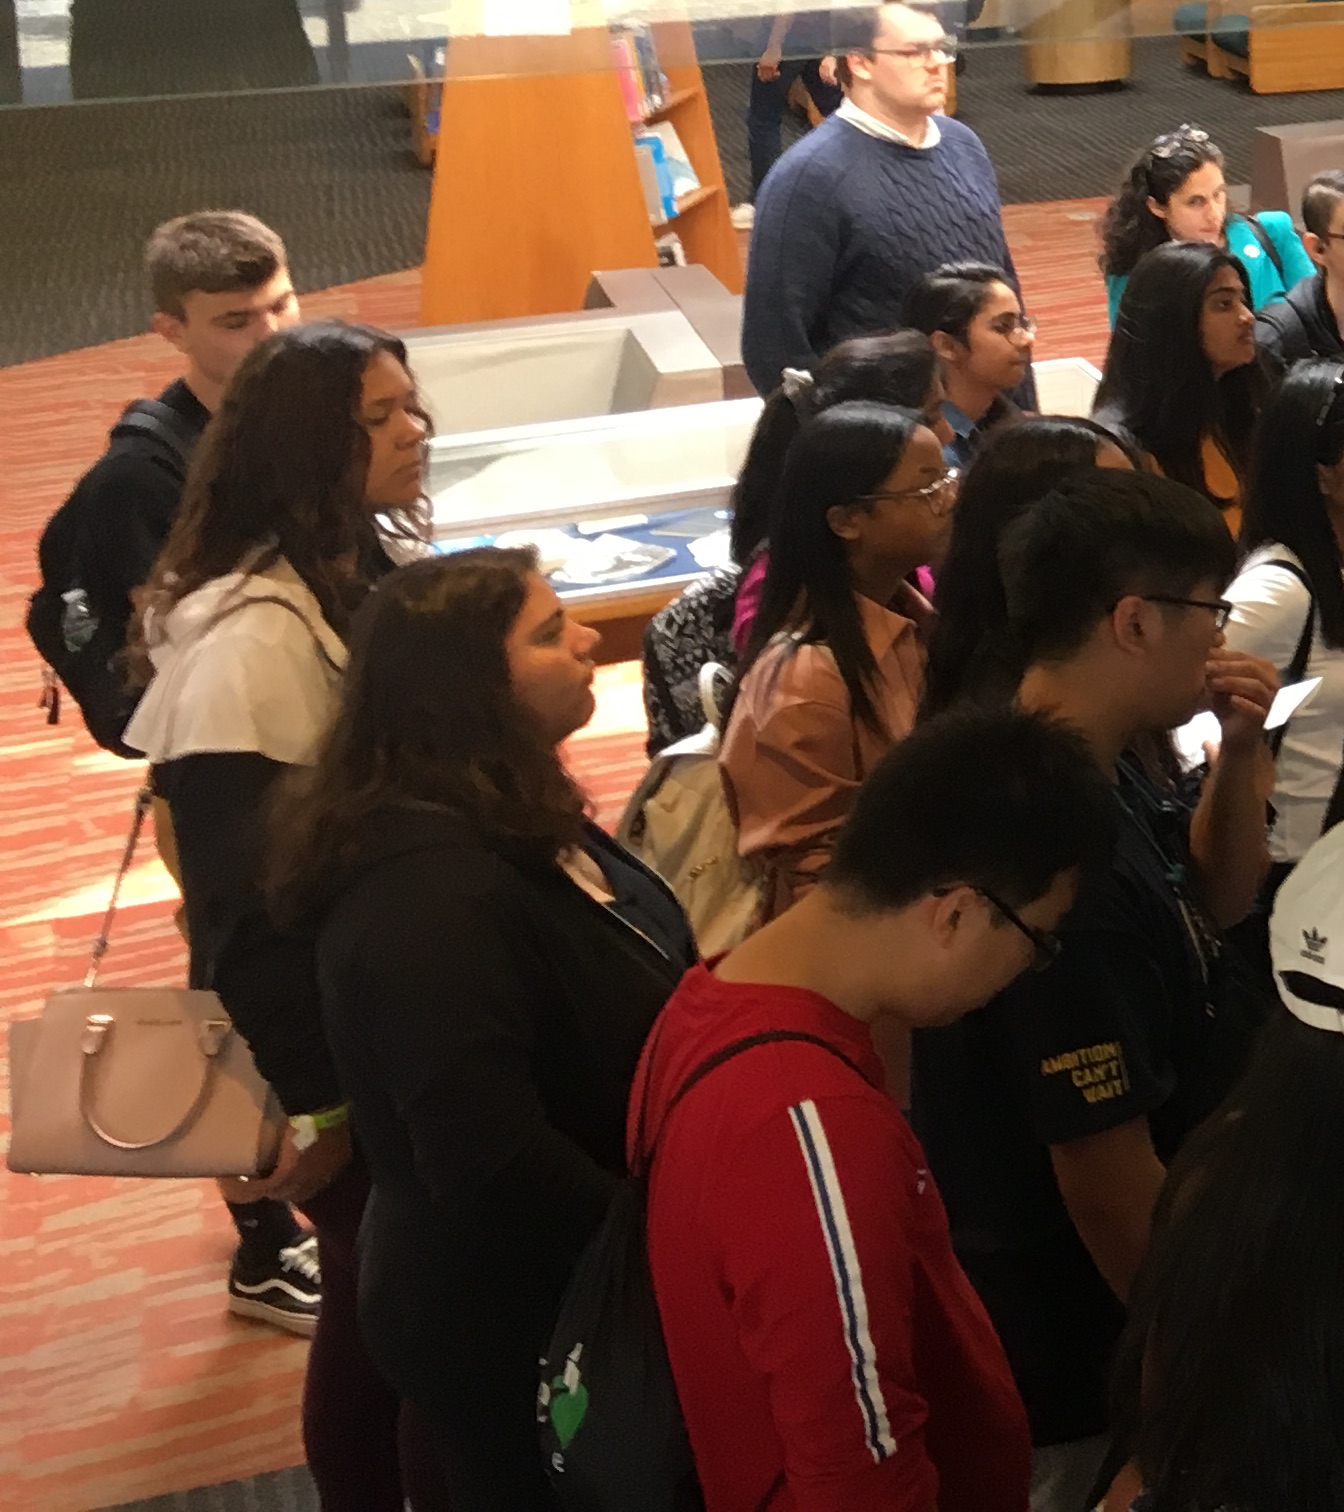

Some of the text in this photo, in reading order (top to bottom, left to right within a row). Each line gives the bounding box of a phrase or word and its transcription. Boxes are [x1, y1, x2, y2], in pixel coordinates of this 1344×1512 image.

[1040, 1041, 1118, 1077] AMBITION
[1071, 1060, 1119, 1087] CAN'T
[1081, 1079, 1124, 1103] WAIT
